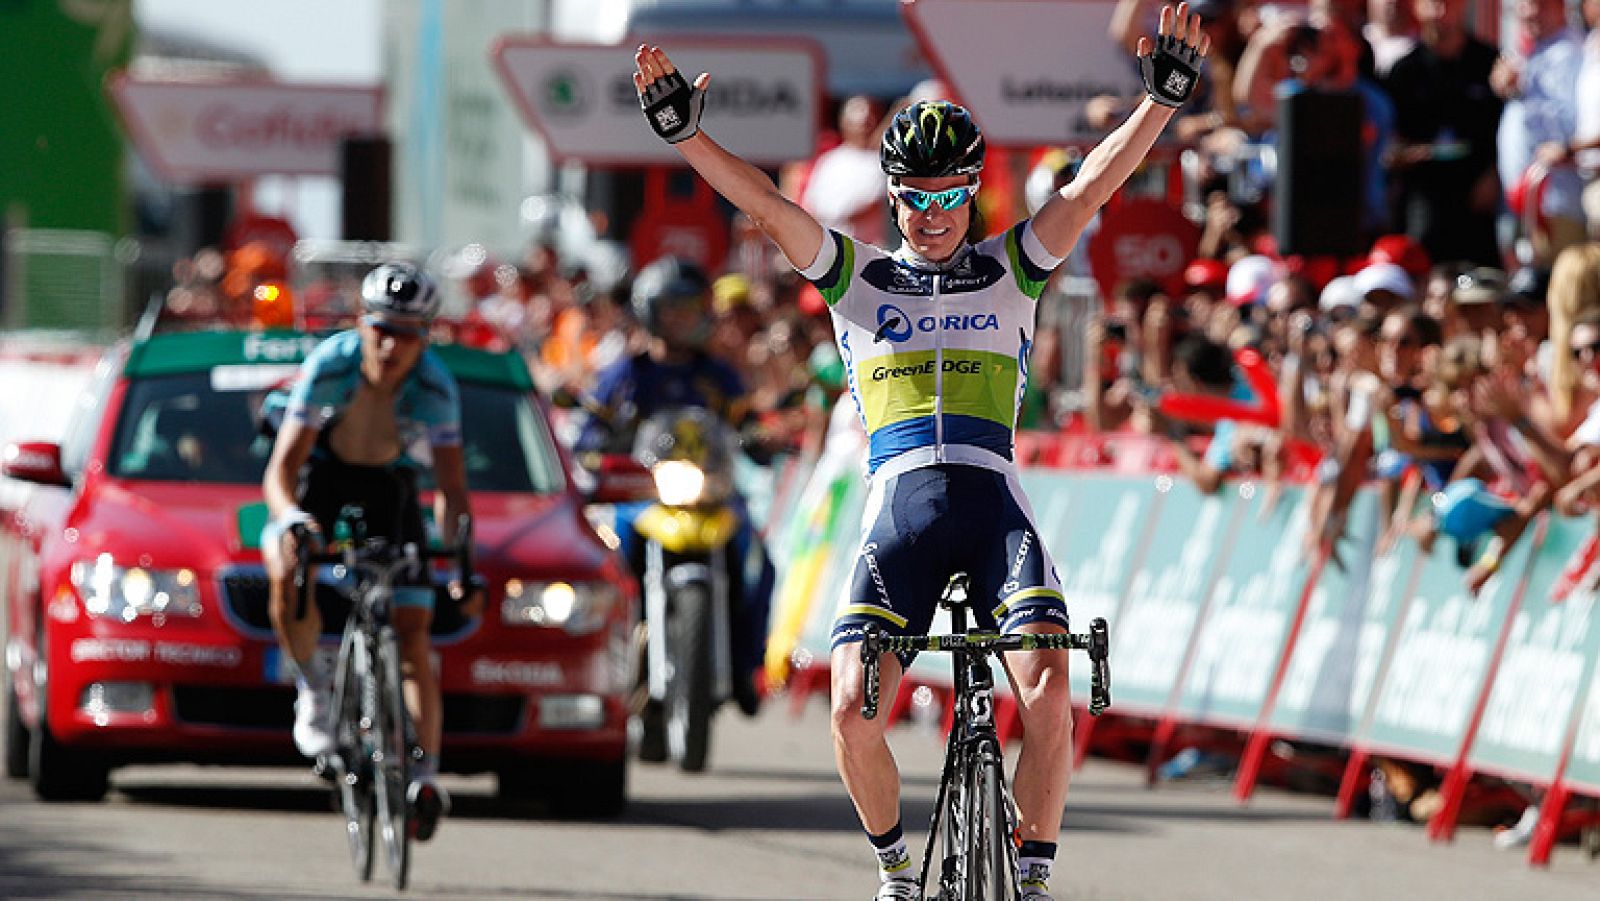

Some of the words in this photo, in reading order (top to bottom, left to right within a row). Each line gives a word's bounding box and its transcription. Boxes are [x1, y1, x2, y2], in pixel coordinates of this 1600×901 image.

[1114, 233, 1184, 277] 50
[917, 313, 999, 333] ORICA
[872, 360, 982, 382] GreenEDGE
